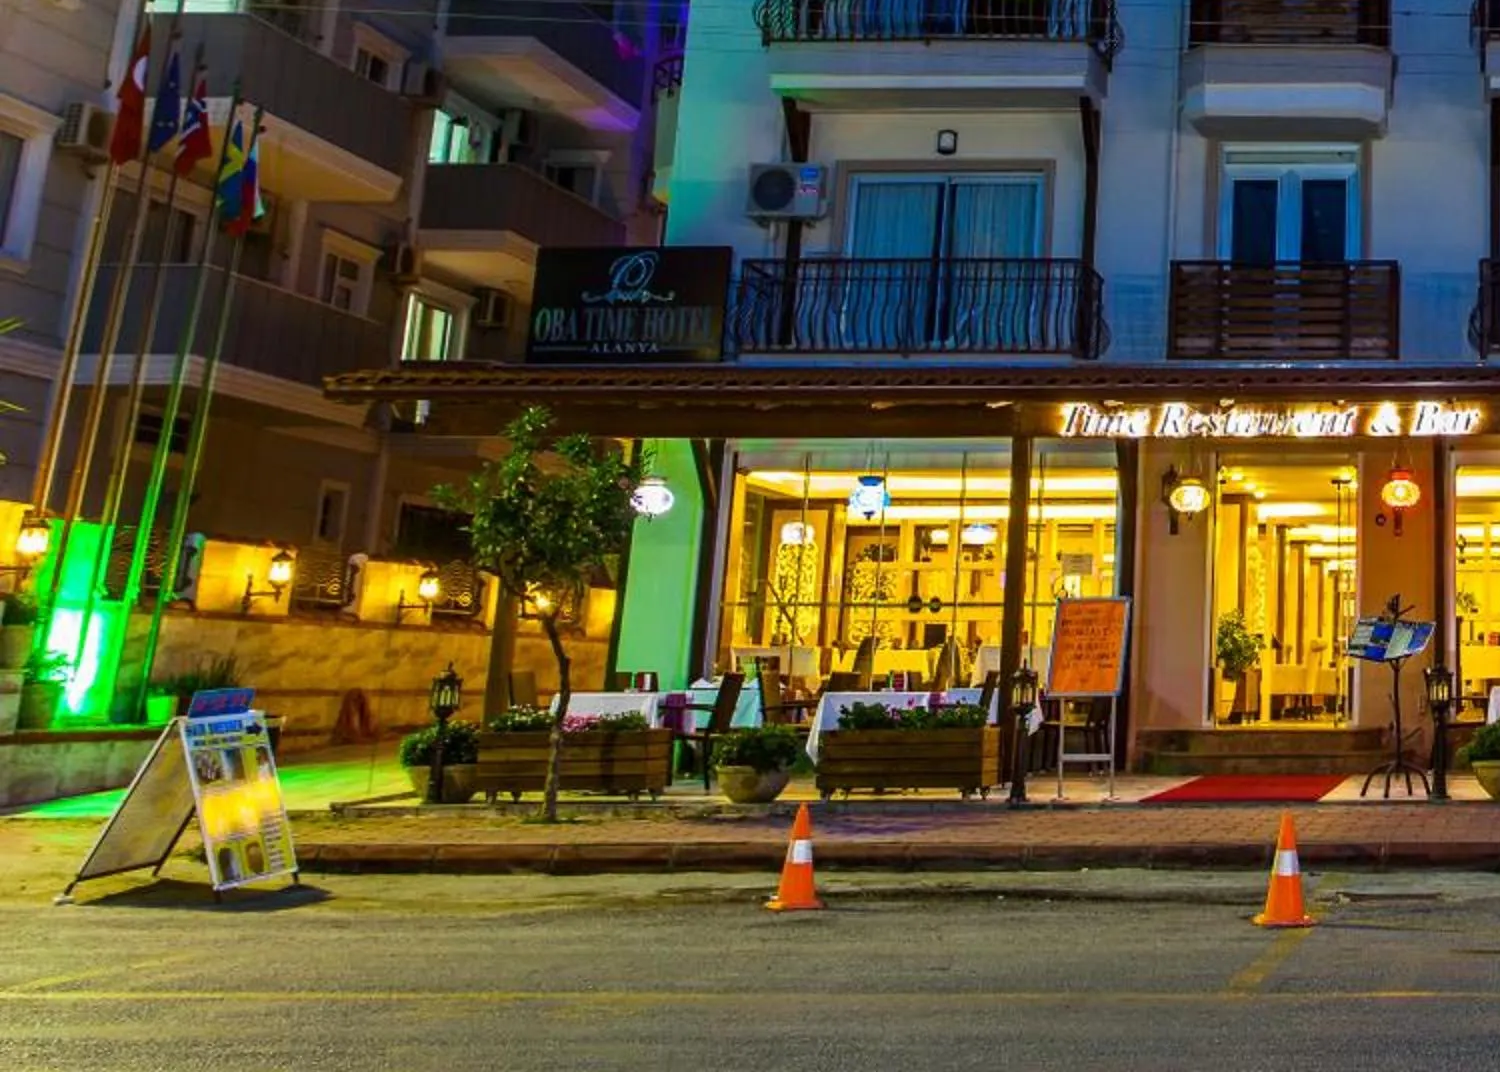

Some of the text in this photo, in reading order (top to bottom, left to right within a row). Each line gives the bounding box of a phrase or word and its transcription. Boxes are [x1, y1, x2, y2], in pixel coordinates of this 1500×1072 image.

[534, 306, 713, 342] OBA TIME HOTEL
[590, 342, 660, 354] ALANYA
[1063, 403, 1150, 436] Time
[1412, 402, 1481, 435] Bar
